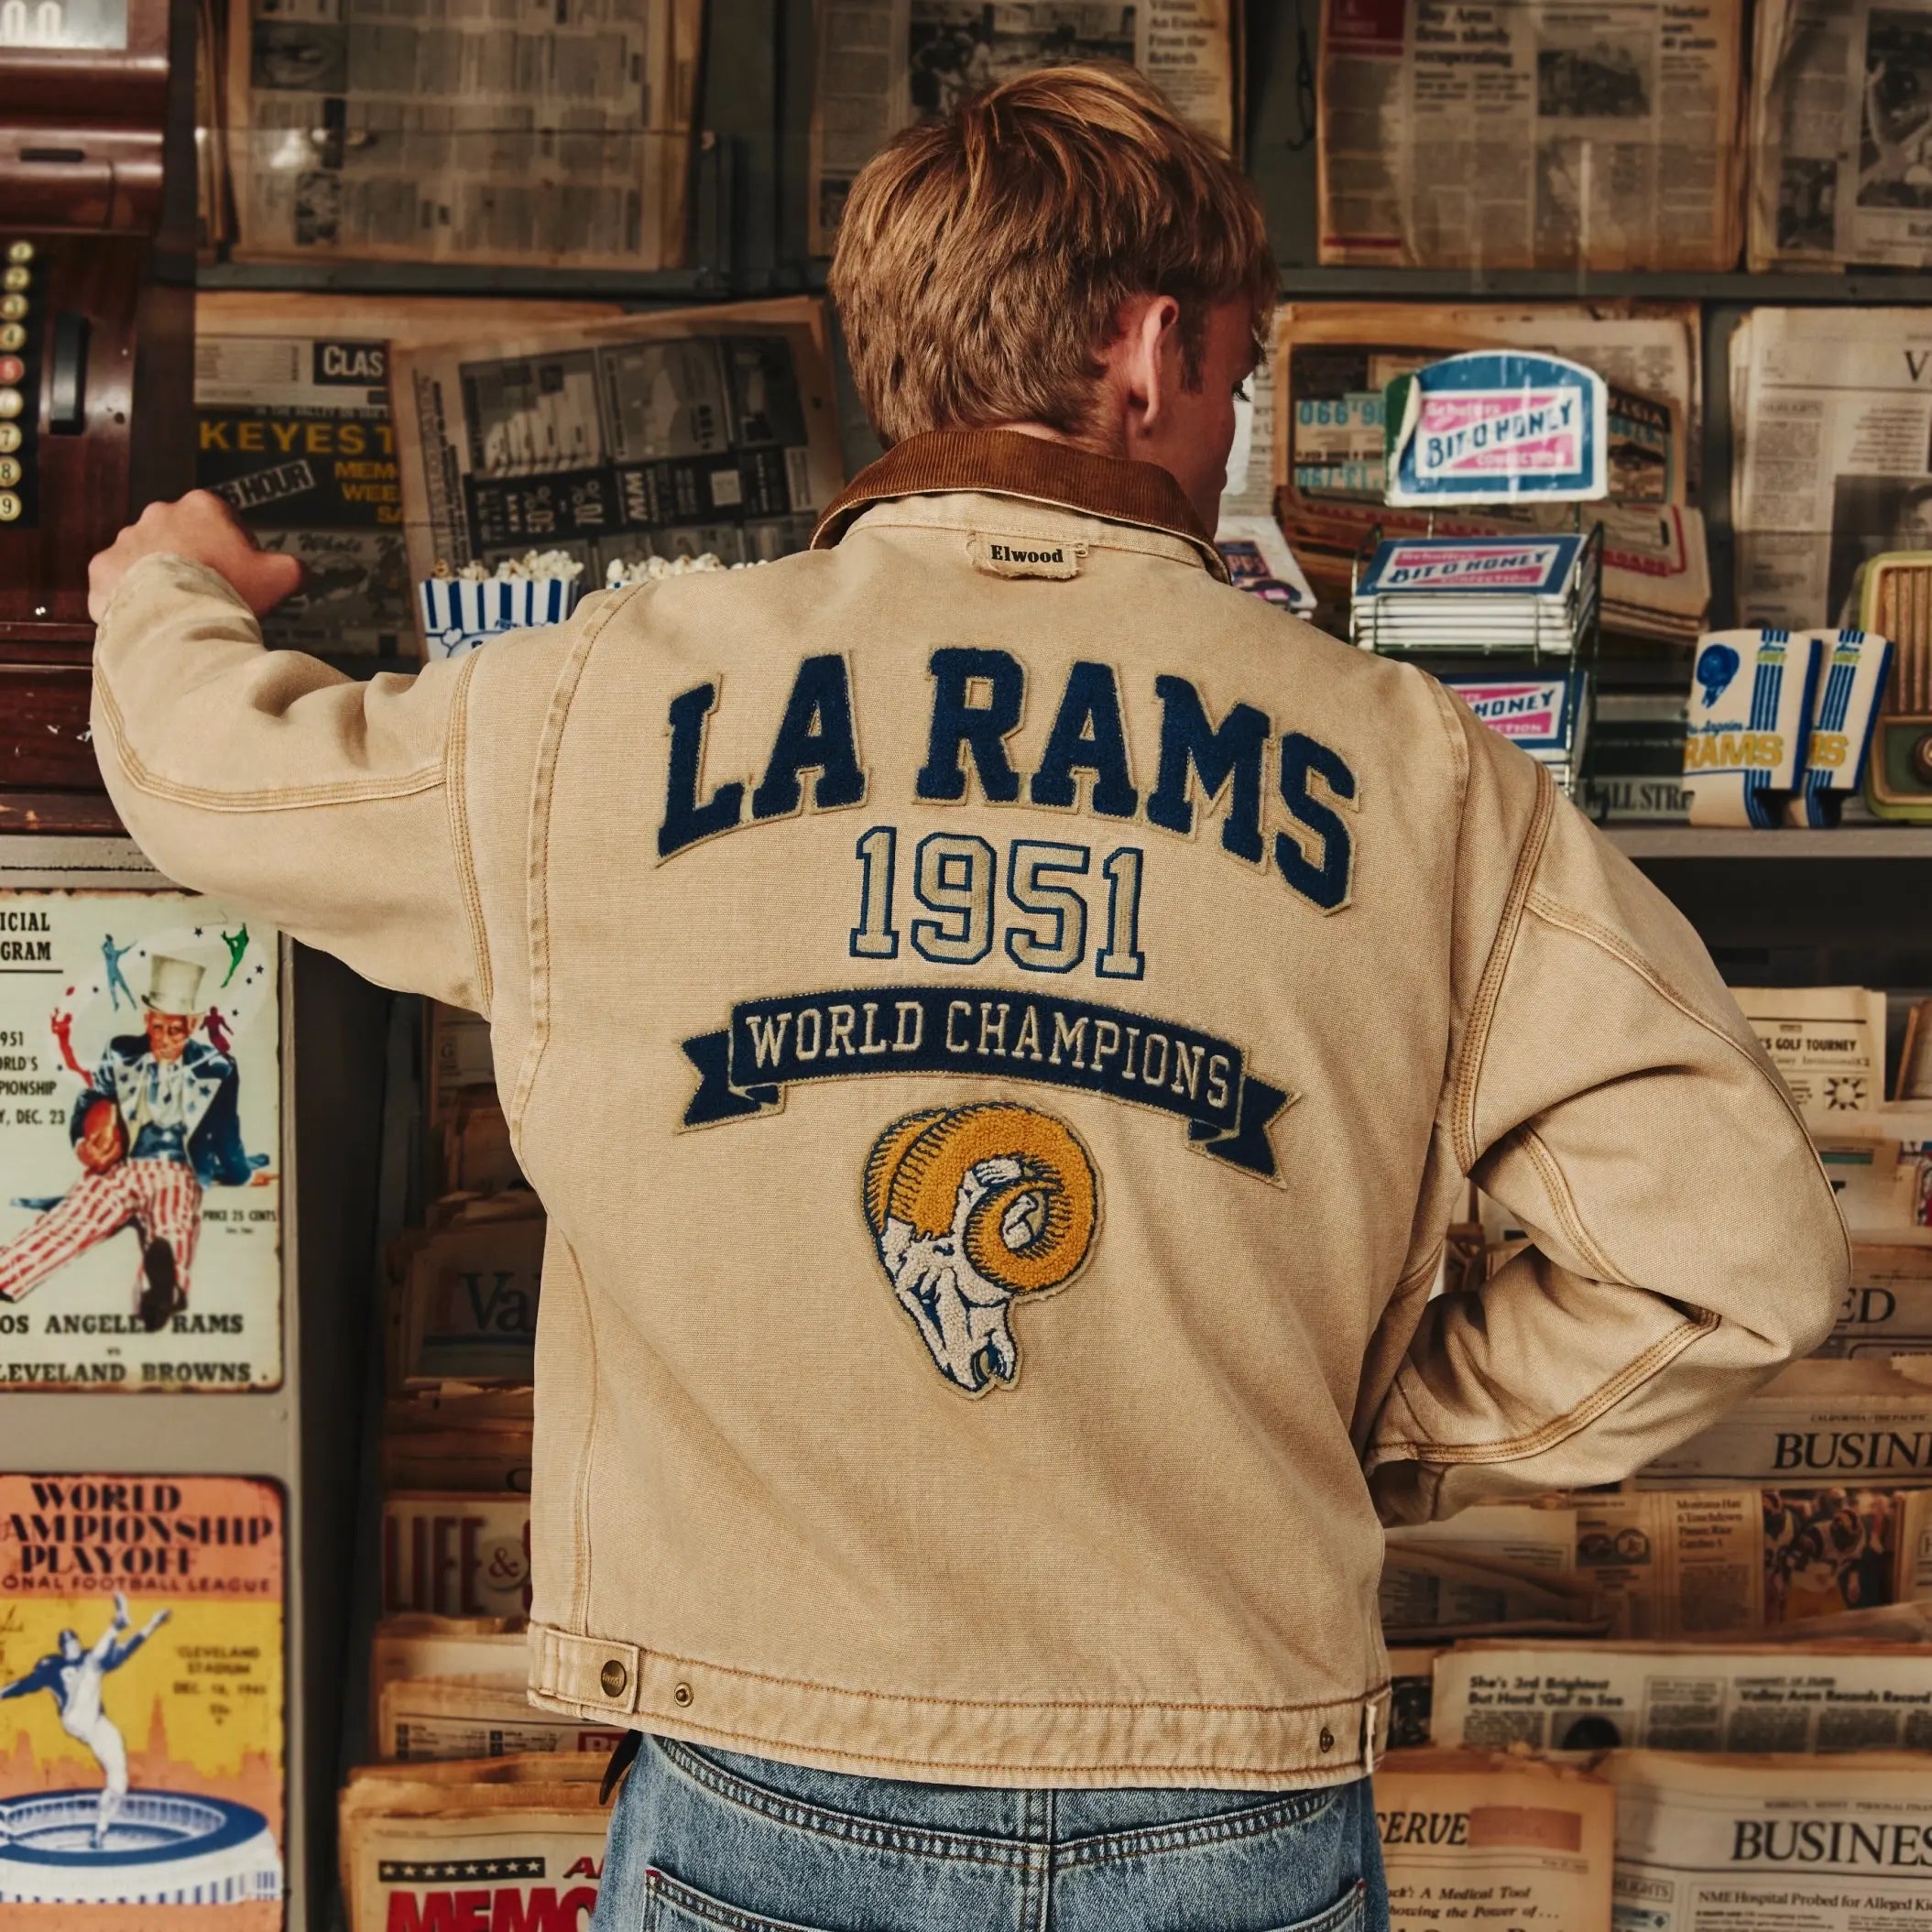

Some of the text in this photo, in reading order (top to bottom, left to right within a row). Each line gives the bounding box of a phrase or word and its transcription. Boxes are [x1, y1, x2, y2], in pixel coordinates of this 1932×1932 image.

[990, 544, 1065, 566] Elwood
[1466, 550, 1551, 572] HONEY
[1474, 689, 1555, 717] HONEY
[1684, 735, 1785, 769] RAMS
[657, 647, 1360, 915] LA RAMS
[849, 825, 1146, 981] 1951
[0, 911, 50, 932] ICIAL
[0, 942, 51, 961] GRAM
[745, 1000, 1231, 1110] WORLD CHAMPIONS
[1775, 1038, 1803, 1051] GOLF
[1806, 1038, 1857, 1052] TOURNEY
[0, 1080, 57, 1097] PIONSHIP
[16, 1109, 43, 1125] DEC.
[49, 1109, 66, 1125] 23
[232, 1209, 245, 1222] 25
[44, 1314, 147, 1335] ANGELE
[171, 1314, 244, 1335] RAMS
[141, 1362, 252, 1382] BROWNS
[31, 1482, 181, 1512] WORLD
[10, 1513, 273, 1545] AMPIONSHIP
[22, 1545, 195, 1574] PLAYOFF
[488, 1546, 519, 1577] &
[2, 1574, 271, 1593] ONAL FOOTBALL LEAGUE
[1469, 1675, 1508, 1689] She's
[1514, 1676, 1540, 1689] 3rd
[1468, 1692, 1493, 1705] But
[1497, 1692, 1535, 1705] Hard
[1420, 1887, 1432, 1899] A
[1438, 1886, 1493, 1900] Medical
[1500, 1885, 1532, 1899] Tool
[1698, 1890, 1731, 1904] NME
[1734, 1891, 1789, 1909] Hospital
[1793, 1893, 1838, 1909] Probed
[1841, 1894, 1861, 1908] for
[1863, 1896, 1914, 1913] Alleged
[1445, 1905, 1468, 1918] the
[1472, 1905, 1517, 1918] Power
